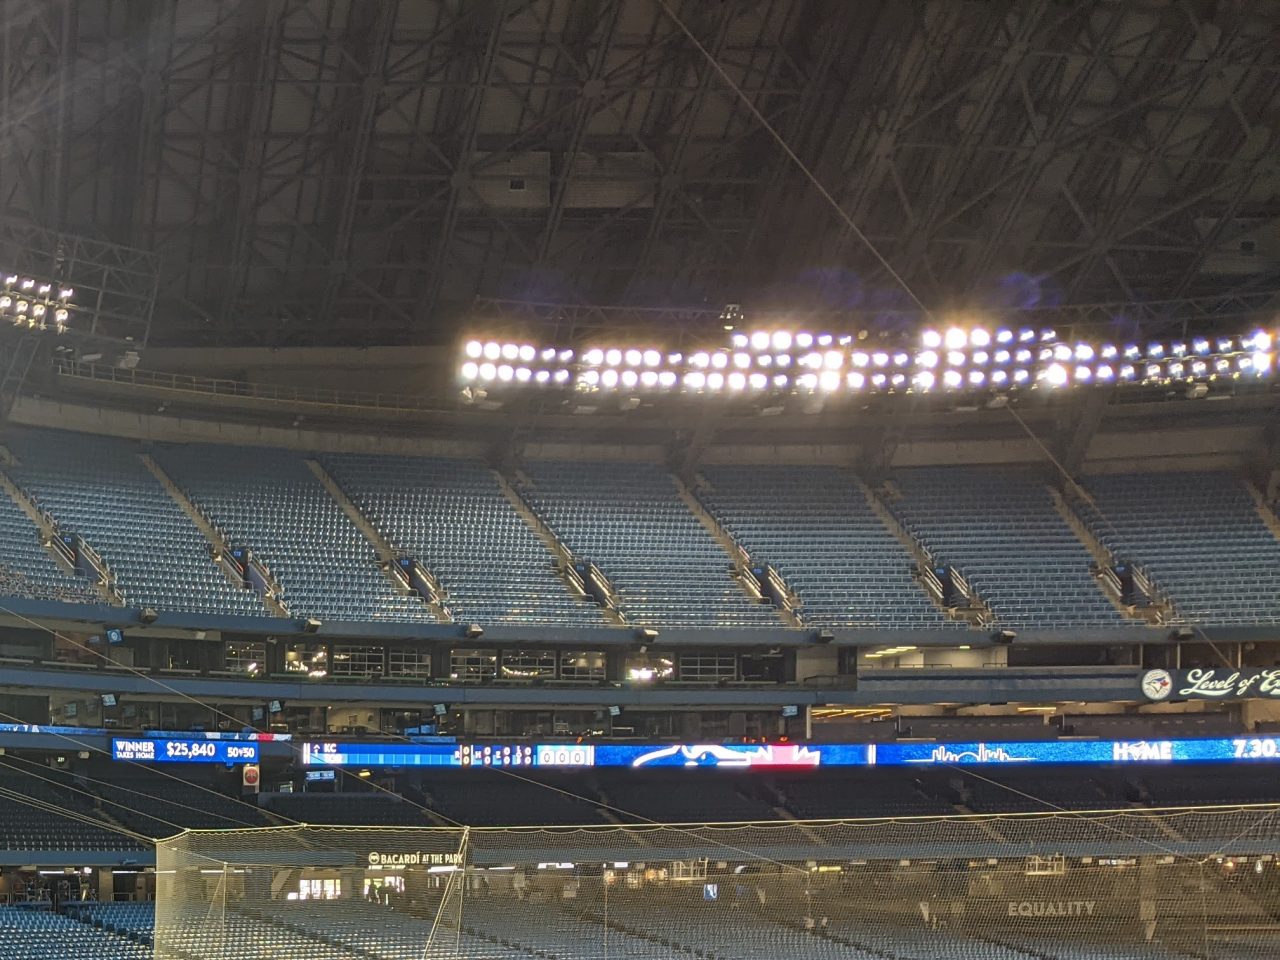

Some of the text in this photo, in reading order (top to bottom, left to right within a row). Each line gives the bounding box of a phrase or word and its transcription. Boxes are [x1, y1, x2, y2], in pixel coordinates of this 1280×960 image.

[1178, 668, 1240, 696] Level
[1236, 674, 1260, 696] of
[115, 741, 155, 752] WINNER
[166, 741, 216, 759] $25,840
[323, 743, 337, 753] KC
[116, 751, 155, 759] TAKES HOME
[380, 851, 463, 865] BACARDÍ AT THE PARK
[1008, 901, 1096, 917] EQUALITY
